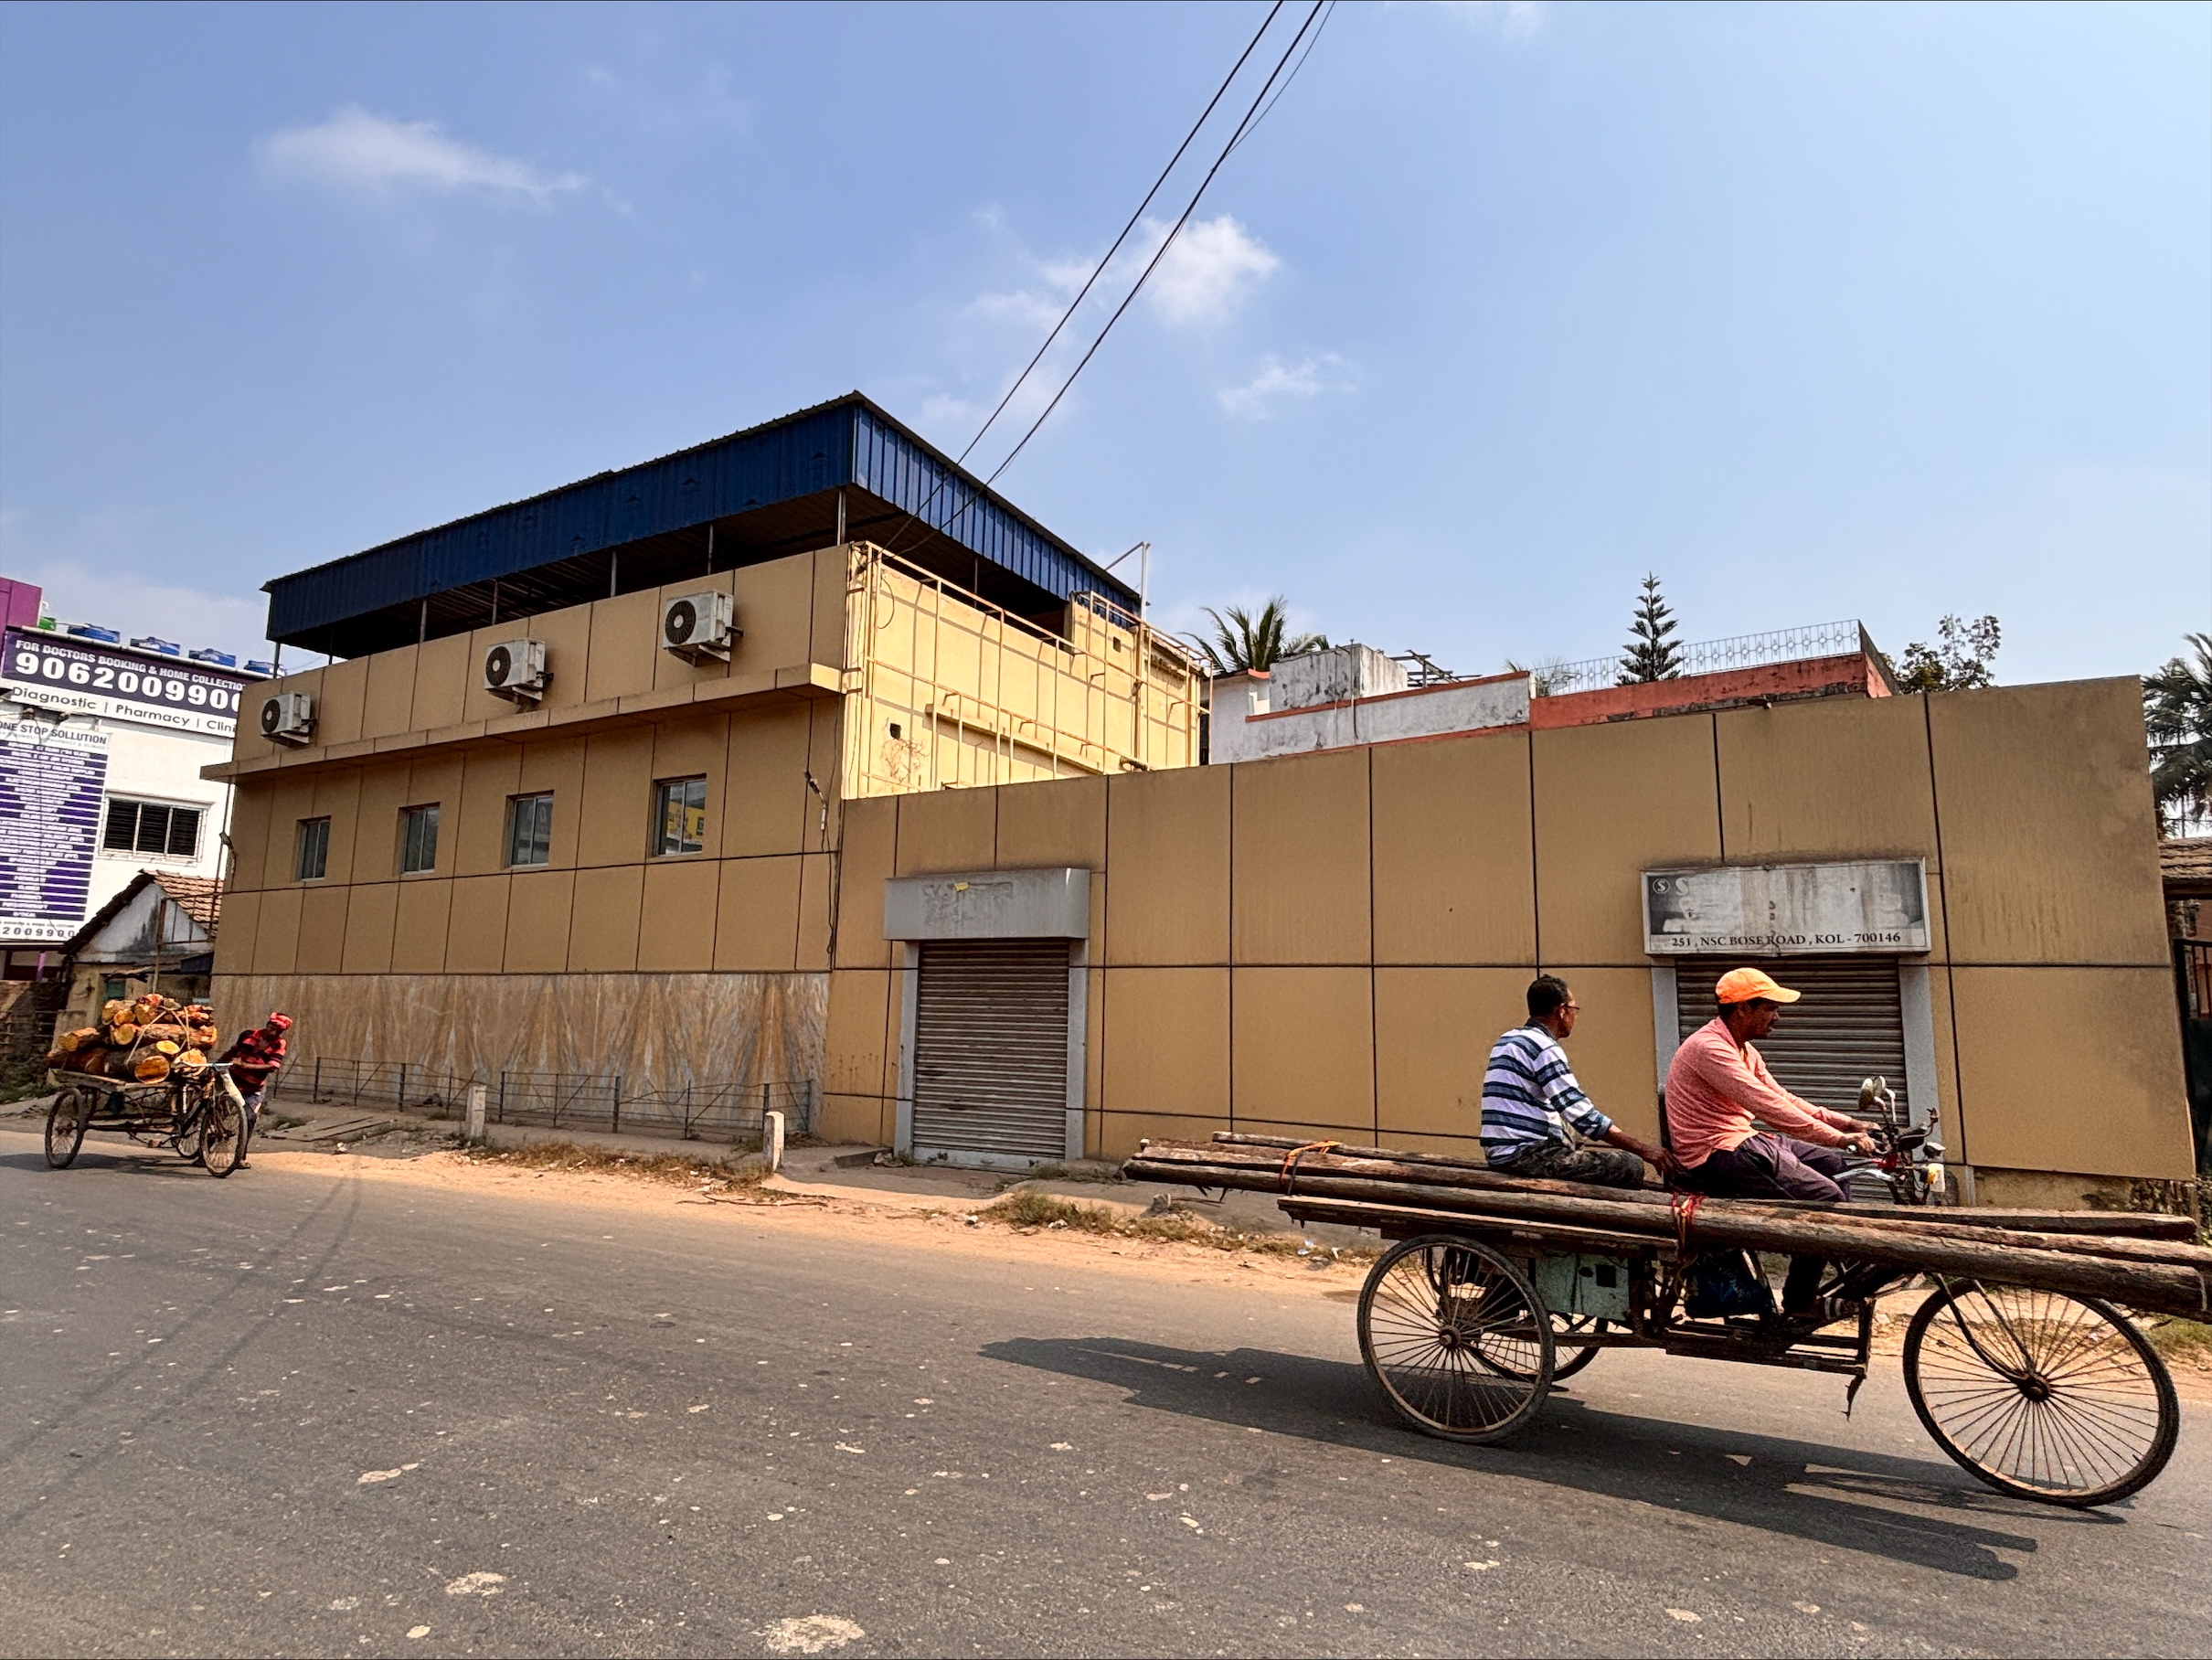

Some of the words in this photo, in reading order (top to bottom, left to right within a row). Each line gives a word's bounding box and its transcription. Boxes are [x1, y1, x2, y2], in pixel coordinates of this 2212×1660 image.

[16, 639, 40, 652] FOR
[42, 644, 96, 663] DOCTORS
[98, 655, 146, 673] BOOKING
[148, 665, 157, 675] &
[159, 667, 190, 681] HOME
[192, 674, 246, 692] COLLECTIO
[12, 686, 97, 709] Diagnostic
[115, 704, 190, 727] Pharmacy
[20, 724, 48, 735] STOP
[50, 729, 107, 745] SOLLUTION
[1700, 936, 1727, 946] NSC
[1729, 935, 1764, 946] BOSE
[1815, 934, 1845, 944] KOL
[1854, 931, 1901, 943] 700146
